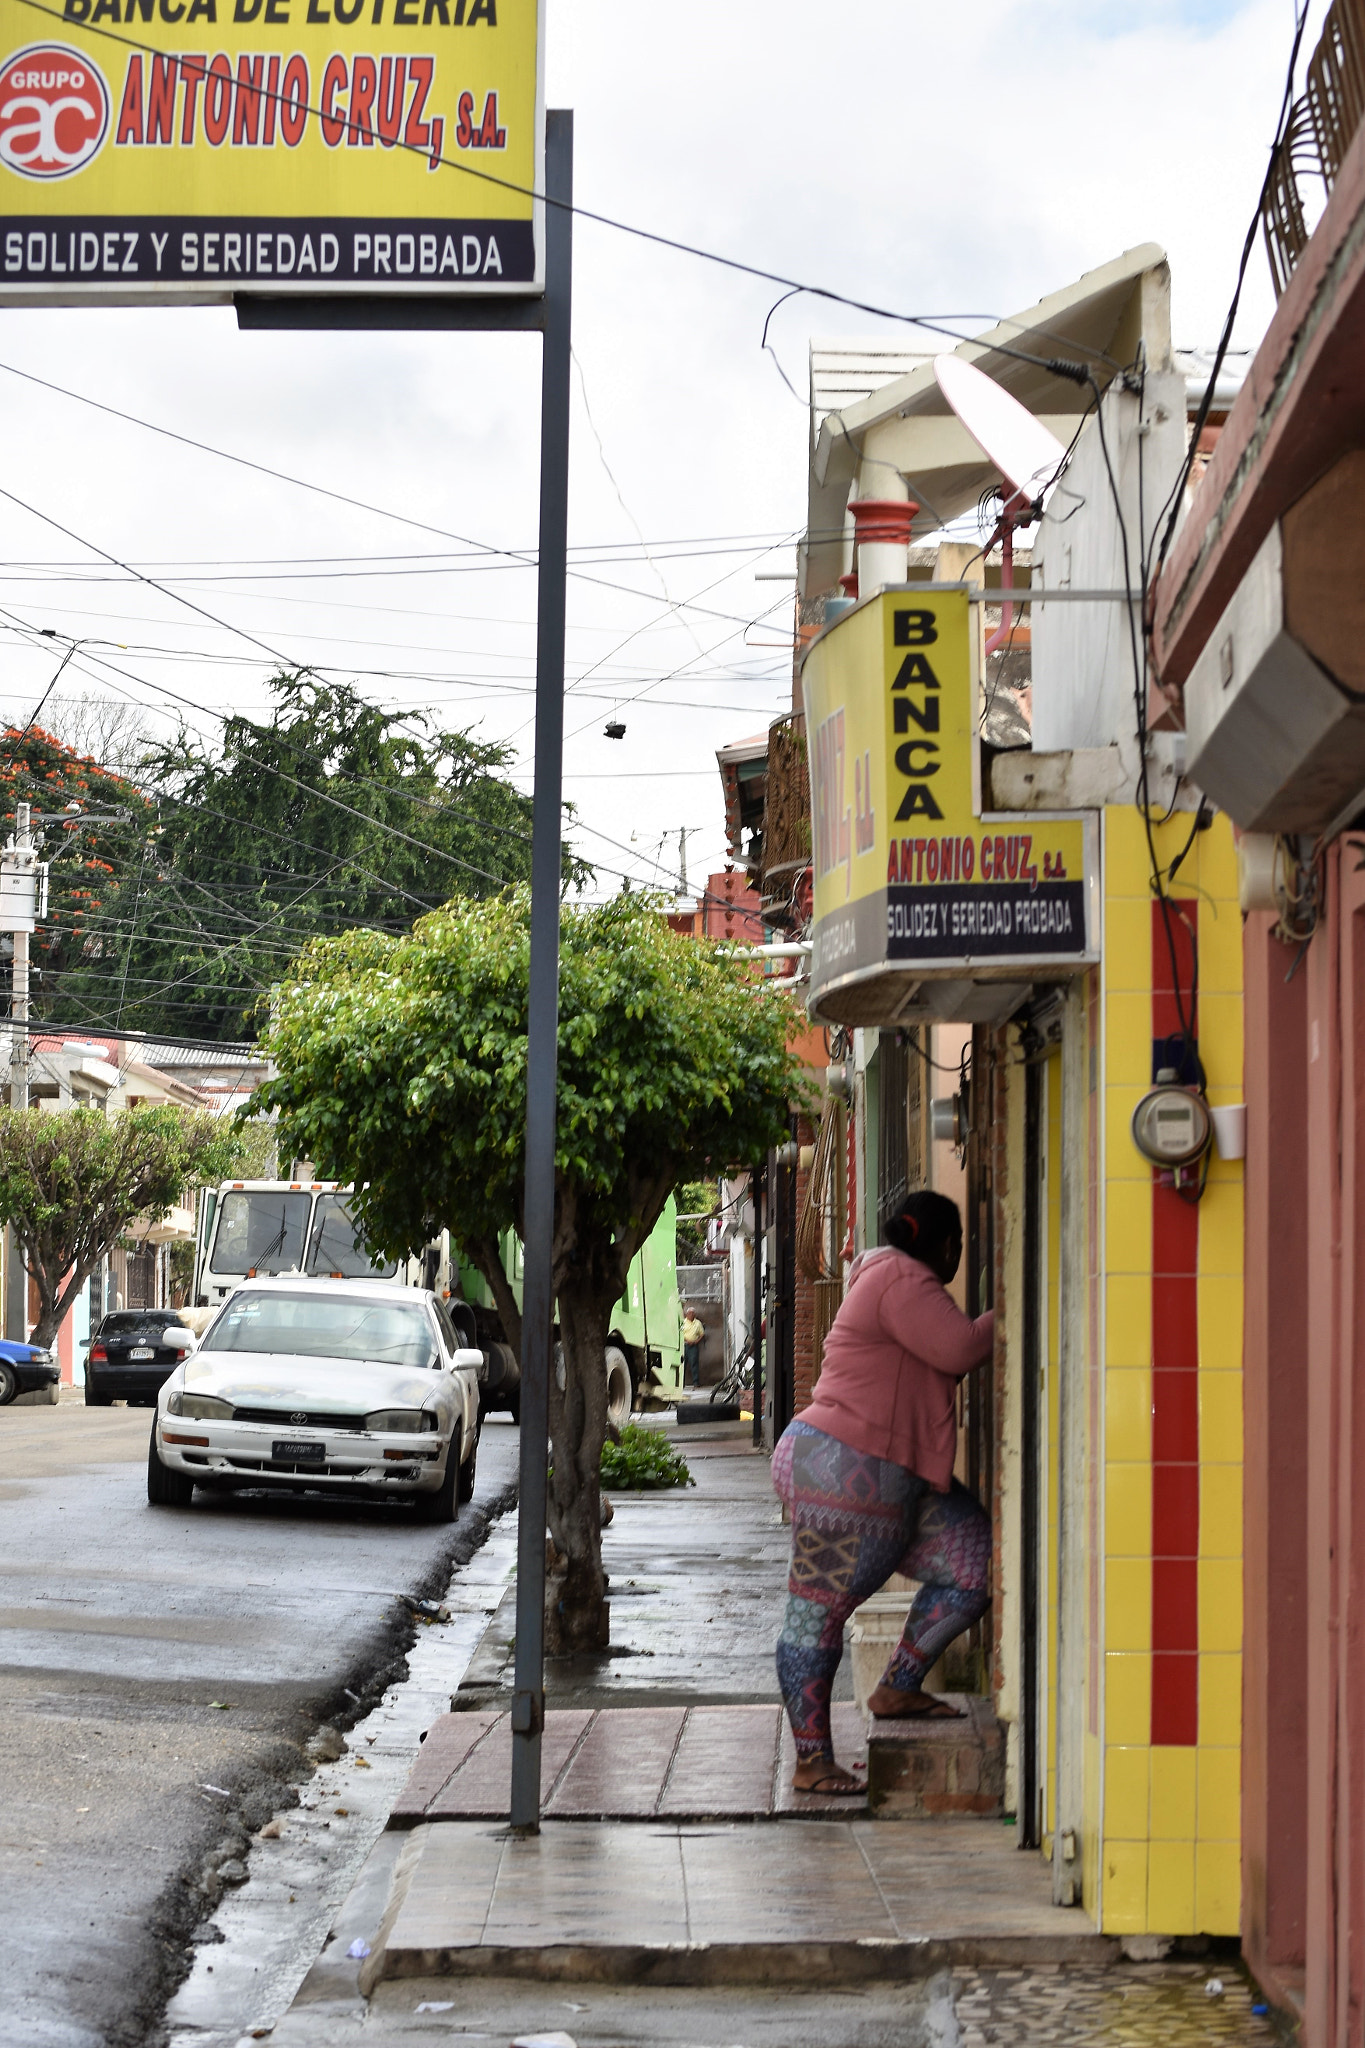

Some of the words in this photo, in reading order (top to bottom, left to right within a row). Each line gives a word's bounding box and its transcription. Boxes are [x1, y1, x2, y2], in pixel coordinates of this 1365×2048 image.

[10, 71, 85, 89] GRUPO
[115, 53, 310, 148] ANTONIO
[320, 54, 444, 171] CRUZ,
[456, 91, 506, 148] S.A.
[5, 232, 139, 272] SOLIDEZ
[150, 232, 169, 272] Y
[181, 233, 339, 274] SERIEDAD
[353, 233, 503, 275] PROBADA
[890, 608, 945, 823] BANCA
[887, 836, 975, 884] ANTONIO
[980, 834, 1038, 892] CRUZ,
[887, 904, 938, 938] SOLIDEZ
[940, 903, 949, 936] Y
[952, 901, 1012, 936] SERIEDAD
[1015, 900, 1073, 935] PROBADA
